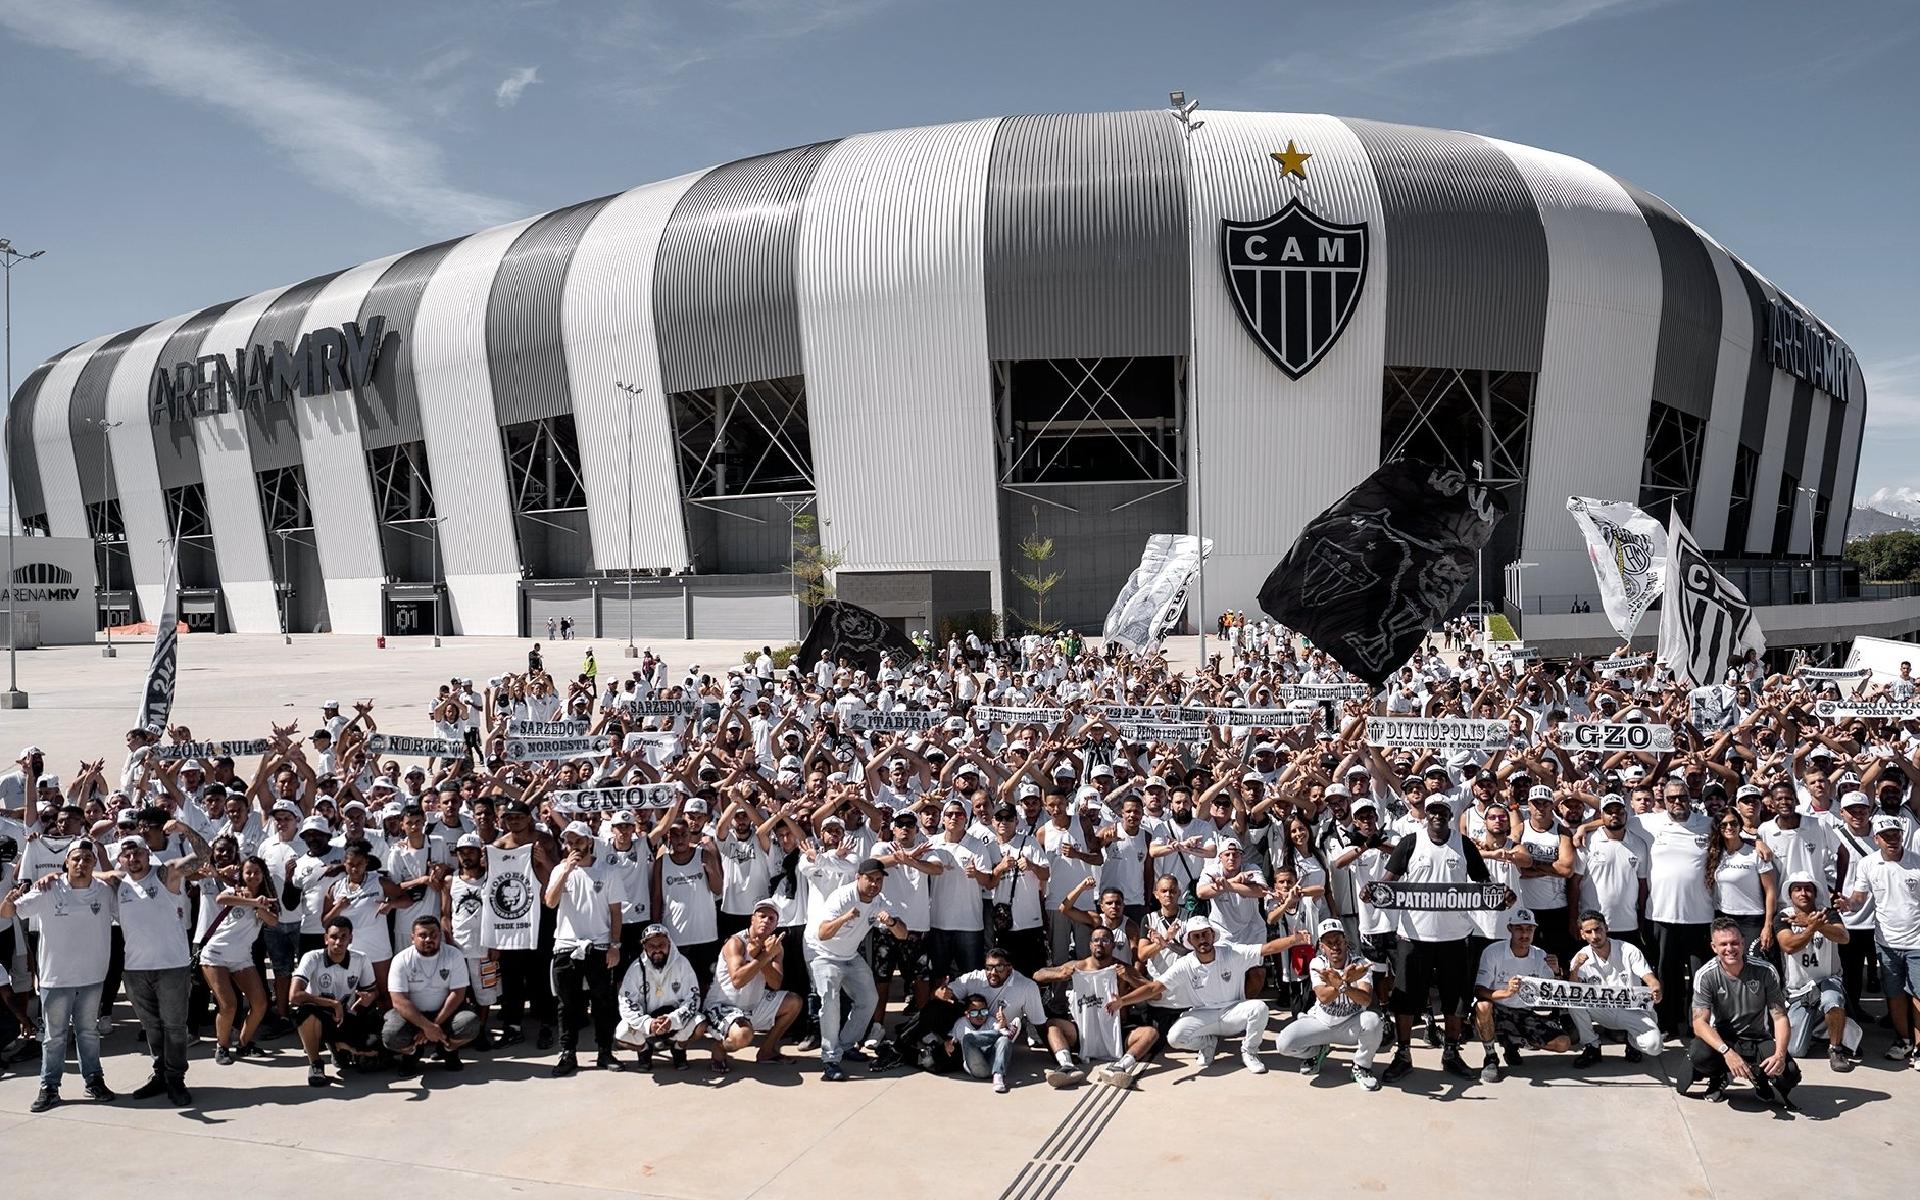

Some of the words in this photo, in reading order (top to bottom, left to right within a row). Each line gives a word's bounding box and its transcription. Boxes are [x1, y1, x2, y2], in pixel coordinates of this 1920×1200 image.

[1244, 235, 1345, 262] CAM
[1293, 685, 1316, 699] PEDRO
[1318, 685, 1351, 700] LEOPOLDO
[630, 700, 683, 716] SARZEDO
[867, 716, 931, 730] ITABIRA
[1229, 710, 1253, 725] PEDRO
[1255, 711, 1293, 726] LEOPOLDO
[519, 721, 574, 736] SARZEDO
[1136, 725, 1160, 740] PEDRO
[1163, 727, 1199, 740] LEOPOLDO
[1386, 719, 1486, 742] DIVINÓPOLIS
[1575, 724, 1652, 749] GZO
[222, 740, 253, 756] SUL
[389, 736, 447, 754] NORTE
[527, 739, 590, 753] NOROESTE
[1387, 740, 1425, 748] IDEOLOGIA
[576, 787, 647, 813] GNO
[1396, 887, 1481, 909] PATRIMÔNIO
[1801, 953, 1819, 968] 84
